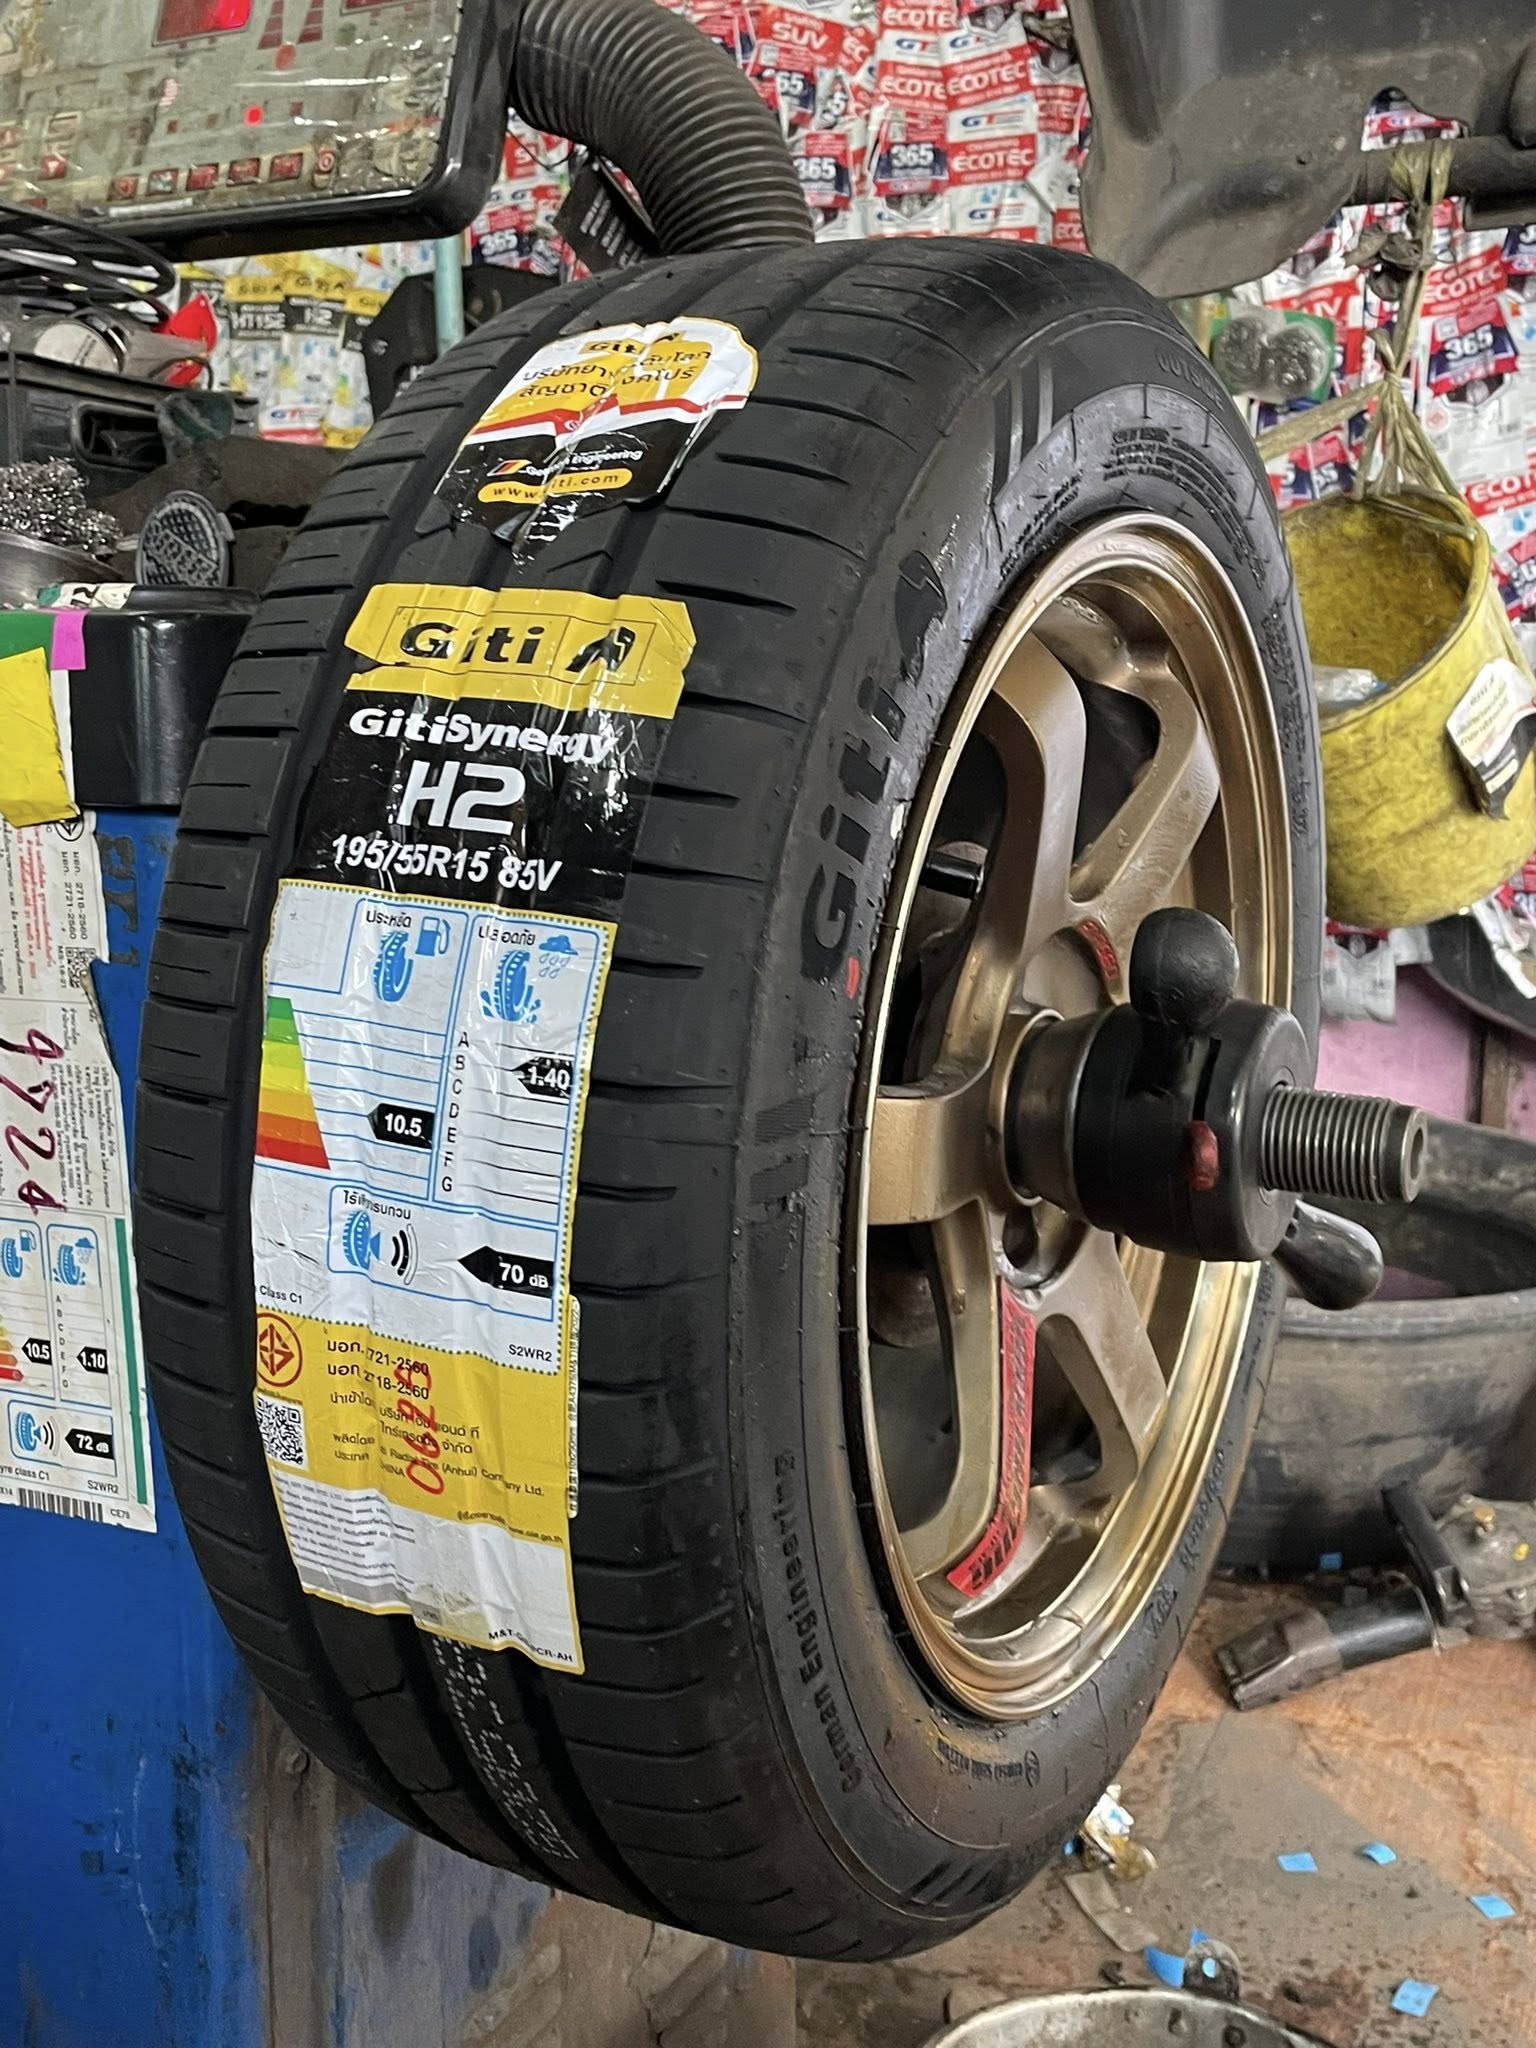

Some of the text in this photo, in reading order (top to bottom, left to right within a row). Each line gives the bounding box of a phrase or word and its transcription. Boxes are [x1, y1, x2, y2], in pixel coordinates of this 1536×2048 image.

[772, 21, 829, 50] SUV
[895, 38, 931, 51] GT
[879, 75, 948, 100] ECOTE
[947, 61, 1027, 97] ECOTEC
[961, 114, 996, 128] GT
[890, 143, 934, 168] 365
[952, 148, 1034, 172] ECOTEC
[480, 229, 518, 256] 365
[304, 308, 334, 326] H2
[1444, 324, 1494, 361] 365
[493, 474, 620, 500] www.iti.com
[1471, 474, 1536, 502] ECOT
[400, 621, 546, 664] Giti
[348, 707, 619, 764] GitiSynergy
[397, 759, 526, 835] H2
[332, 833, 565, 893] 195/55R15 85V
[64, 882, 76, 940] 2721-2560
[75, 882, 88, 940] 2718-2560
[457, 1031, 470, 1049] A
[455, 1054, 466, 1071] B
[452, 1078, 463, 1095] C
[528, 1066, 571, 1090] 1.40
[449, 1102, 461, 1119] D
[384, 1112, 423, 1137] 10.5
[446, 1127, 457, 1144] E
[441, 1176, 454, 1192] G
[499, 1261, 550, 1290] 70 dB
[259, 1284, 303, 1305] Class C1
[26, 1342, 50, 1359] 10.5
[80, 1351, 105, 1369] 1.10
[508, 1344, 553, 1363] S2WR2
[76, 1434, 93, 1450] 72
[14, 1466, 35, 1479] class
[37, 1468, 50, 1480] C1
[442, 1460, 478, 1477] (Anhui)
[481, 1469, 521, 1494] Comany
[525, 1483, 545, 1497] Ltd.
[87, 1479, 119, 1494] S2WR2
